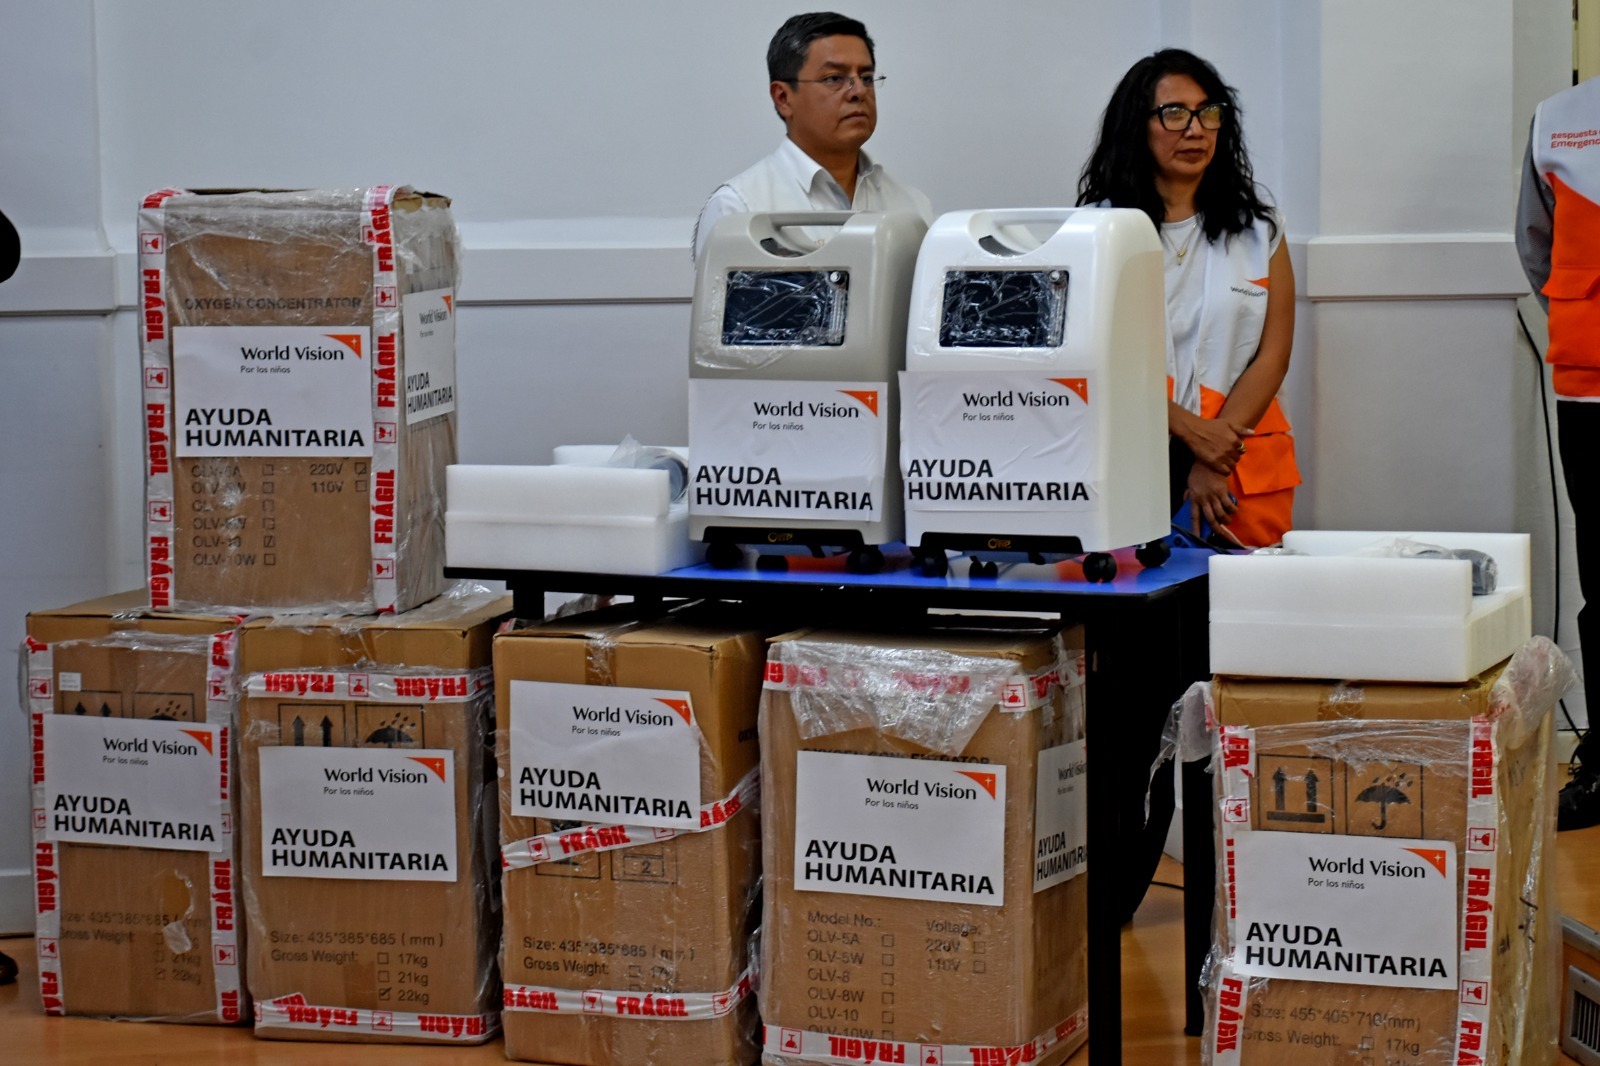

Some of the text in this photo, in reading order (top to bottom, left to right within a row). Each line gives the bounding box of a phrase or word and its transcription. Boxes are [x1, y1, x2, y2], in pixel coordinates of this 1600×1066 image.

[1552, 129, 1597, 140] Respuesta
[144, 269, 165, 342] FRÁGIL
[185, 297, 362, 310] OXYGEN CONCENTRATOR
[420, 308, 448, 325] World Vision
[240, 346, 344, 361] World Vision
[240, 365, 290, 374] Por los niños
[374, 333, 396, 407] FRÁGIL
[407, 372, 430, 394] AYUDA
[408, 386, 453, 415] HUMANITARIA
[963, 391, 1070, 407] World Vision
[185, 408, 272, 426] AYUDA
[754, 401, 859, 418] World Vision
[963, 412, 1014, 422] Por los niños
[753, 421, 804, 431] Por los niños
[146, 404, 168, 476] FRÁGIL
[185, 429, 364, 448] HUMANITARIA
[309, 463, 342, 476] 220V
[696, 465, 782, 486] AYUDA
[908, 459, 994, 478] AYUDA
[311, 482, 344, 493] 110V
[908, 482, 1090, 501] HUMANITARIA
[371, 469, 394, 544] FRÁGIL
[696, 487, 873, 510] HUMANITARIA
[150, 536, 172, 608] FRÁGIL
[263, 674, 334, 696] FRÁGIL
[394, 677, 467, 701] FRÁGIL
[572, 706, 673, 727] World Vision
[572, 726, 621, 737] Por los niños
[103, 738, 197, 756] World Vision
[103, 755, 148, 766] Por los niños
[324, 767, 428, 784] World Vision
[519, 766, 601, 790] AYUDA
[1058, 763, 1074, 782] World
[324, 786, 374, 796] Por los niños
[866, 777, 977, 800] World Vision
[54, 794, 132, 816] AYUDA
[520, 788, 692, 819] HUMANITARIA
[865, 798, 919, 810] Por los niños
[54, 814, 216, 842] HUMANITARIA
[271, 828, 356, 848] AYUDA
[558, 824, 631, 854] FRÁGIL
[1037, 831, 1066, 859] AYUDA
[272, 849, 449, 871] HUMANITARIA
[805, 839, 897, 864] AYUDA
[642, 861, 650, 873] 2
[1308, 856, 1426, 879] World Vision
[36, 842, 58, 914] FRÁGIL
[805, 862, 994, 895] HUMANITARIA
[1308, 877, 1365, 890] Por los niños
[212, 859, 233, 930] FRÁGIL
[808, 911, 882, 928] Model No.:
[1464, 867, 1492, 952] FRÁGIL
[270, 930, 304, 944] Size:
[926, 920, 982, 937] Voltage:
[1246, 922, 1342, 948] AYUDA
[524, 937, 556, 951] Size:
[808, 930, 961, 953] OLV-5A 220V
[271, 949, 428, 969] Gross Weight: 17kg
[524, 956, 560, 971] Gross
[564, 959, 610, 976] Weight:
[808, 949, 960, 972] OLV-5W 110V
[1245, 946, 1448, 978] HUMANITARIA
[398, 971, 429, 988] 21kg
[808, 968, 850, 983] OLV-8
[398, 990, 430, 1006] 22kg
[616, 993, 689, 1017] FRÁGIL
[808, 988, 864, 1004] OLV-8W
[286, 1006, 358, 1028] FRÁGIL
[808, 1006, 860, 1021] OLV-10
[1216, 977, 1244, 1054] FRÁGIL
[1252, 1004, 1285, 1020] Size:
[418, 1014, 487, 1038] FRÁGIL
[828, 1036, 906, 1066] FRÁGIL
[1287, 1030, 1340, 1048] Weight:
[1386, 1038, 1420, 1056] 17kg
